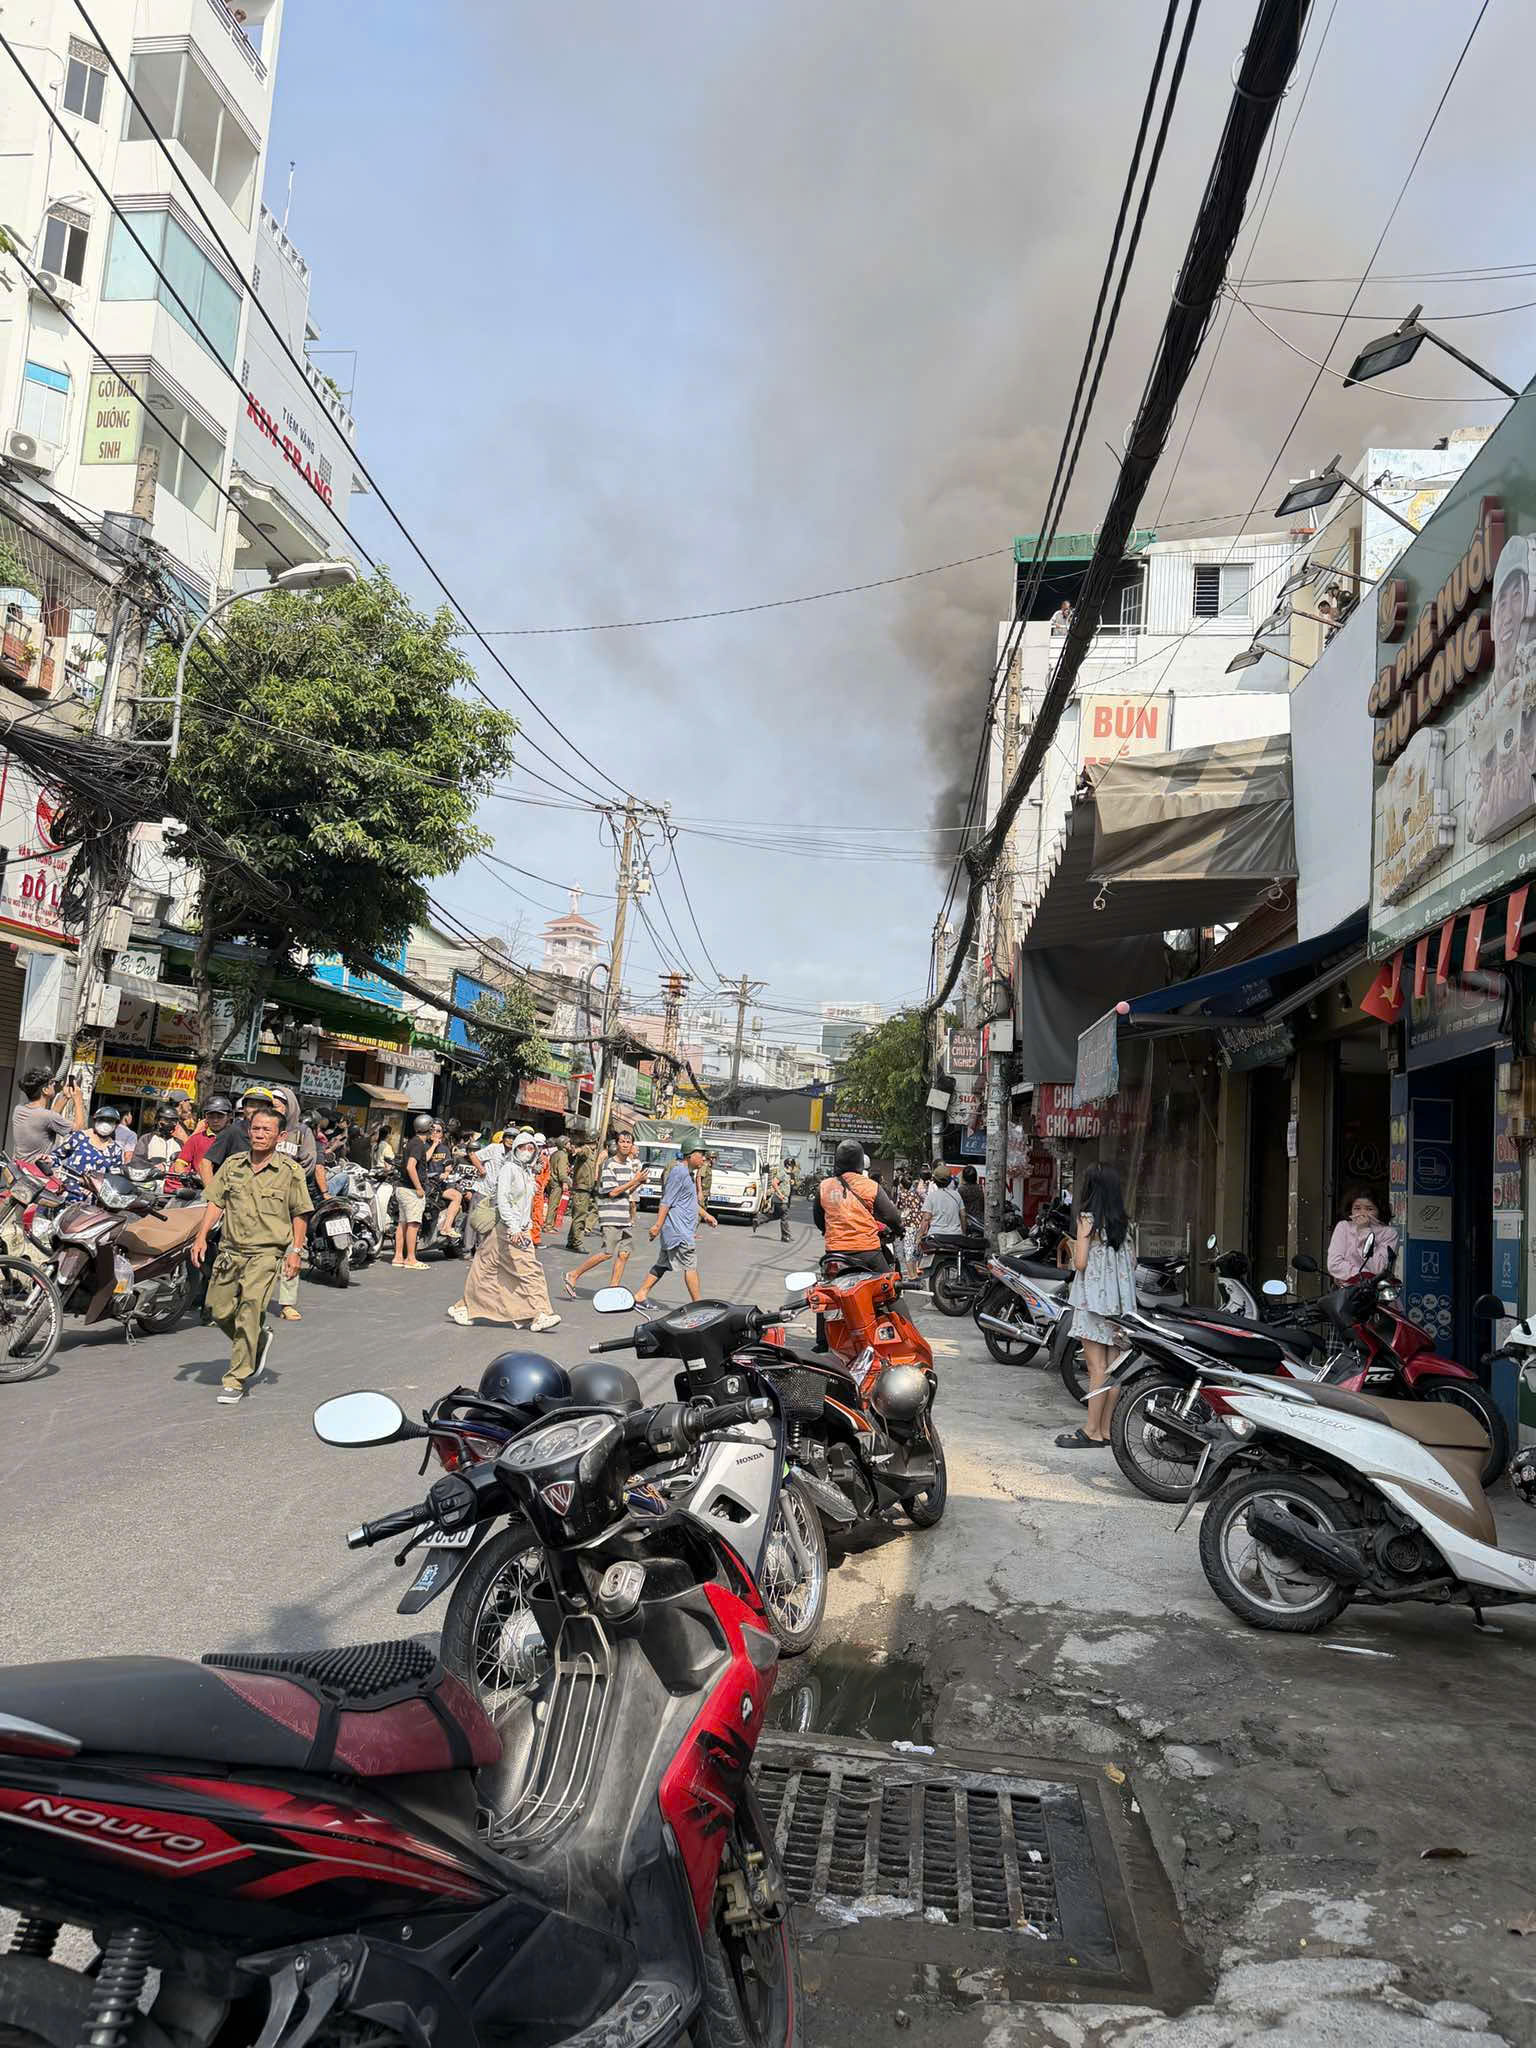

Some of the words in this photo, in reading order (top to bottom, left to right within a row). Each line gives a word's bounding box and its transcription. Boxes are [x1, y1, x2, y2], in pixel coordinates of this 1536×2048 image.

[98, 441, 121, 459] SINH
[282, 434, 333, 506] TRANG
[1416, 607, 1492, 732] LONG
[1093, 699, 1158, 739] BÚN
[20, 868, 47, 901] ĐỖ
[735, 1451, 765, 1465] HONDA
[22, 1798, 206, 1853] NOUVO
